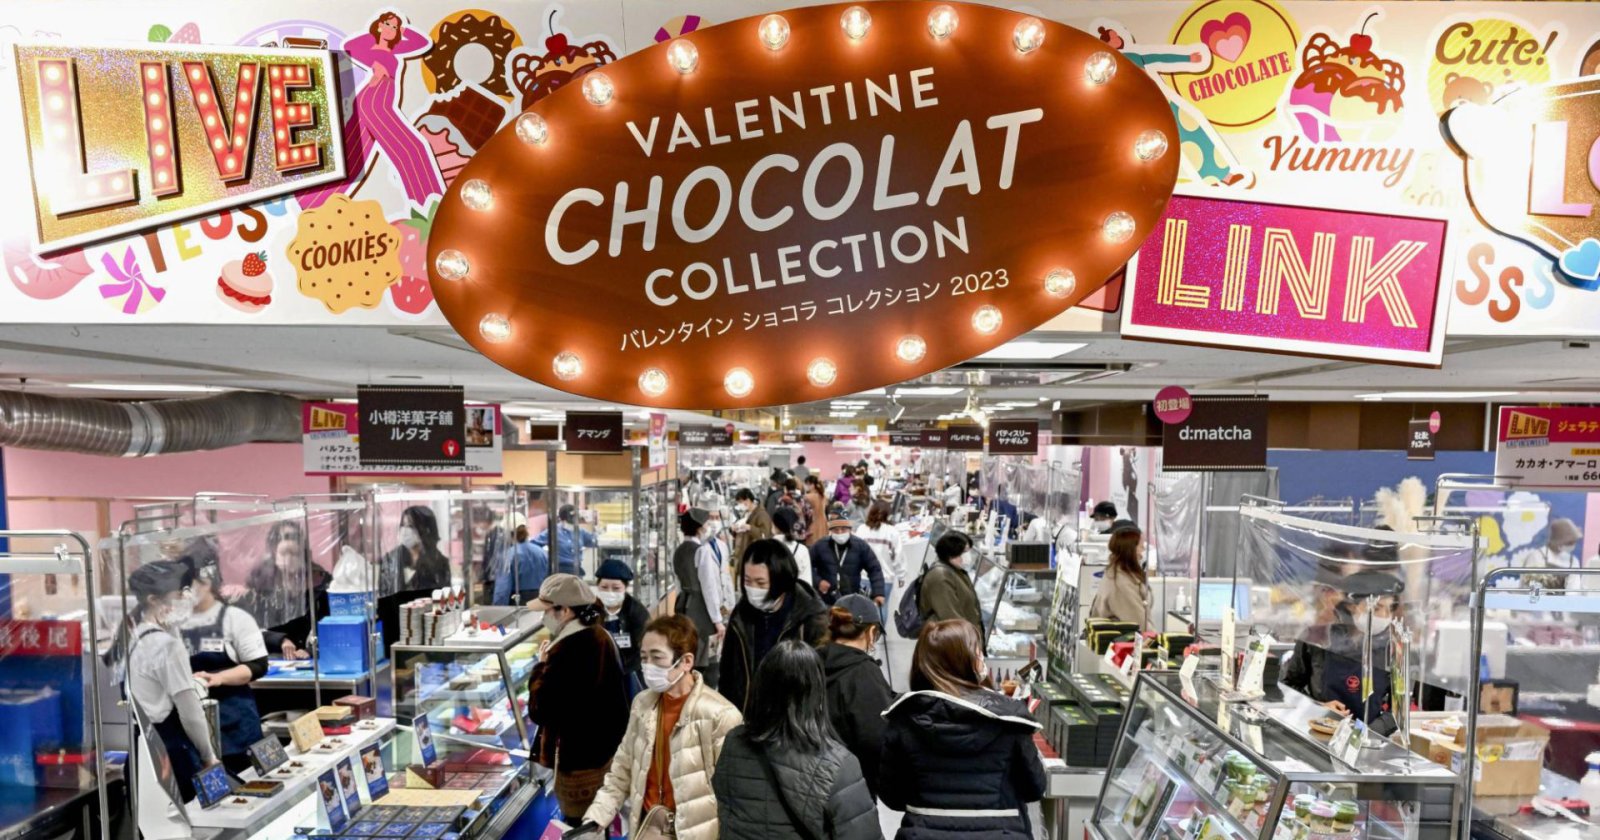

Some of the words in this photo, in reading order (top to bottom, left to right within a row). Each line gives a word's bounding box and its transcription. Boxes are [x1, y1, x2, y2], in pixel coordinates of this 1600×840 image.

[1435, 22, 1559, 67] Cute!
[1188, 51, 1292, 103] CHOCOLATE
[626, 67, 939, 157] VALENTINE
[35, 58, 321, 215] LIVE
[1264, 136, 1415, 187] Yummy
[1529, 120, 1600, 217] L
[545, 108, 1044, 266] CHOCOLAT
[301, 232, 388, 271] COOKIES
[644, 216, 969, 307] COLLECTION
[1156, 218, 1428, 328] LINK
[621, 317, 734, 352] バレンタイン
[743, 301, 818, 330] ショコラ
[826, 281, 941, 315] コレクション
[949, 268, 1010, 296] 2023
[312, 408, 346, 428] LIVE
[369, 410, 454, 425] 小樽洋菓子舗
[390, 428, 432, 441] ルタオ
[577, 429, 611, 438] アマンダ
[995, 430, 1032, 438] パティスリー
[1179, 425, 1252, 440] d:matcha
[1510, 413, 1549, 435] LIVE
[1515, 458, 1597, 469] カカオ・アマーロ
